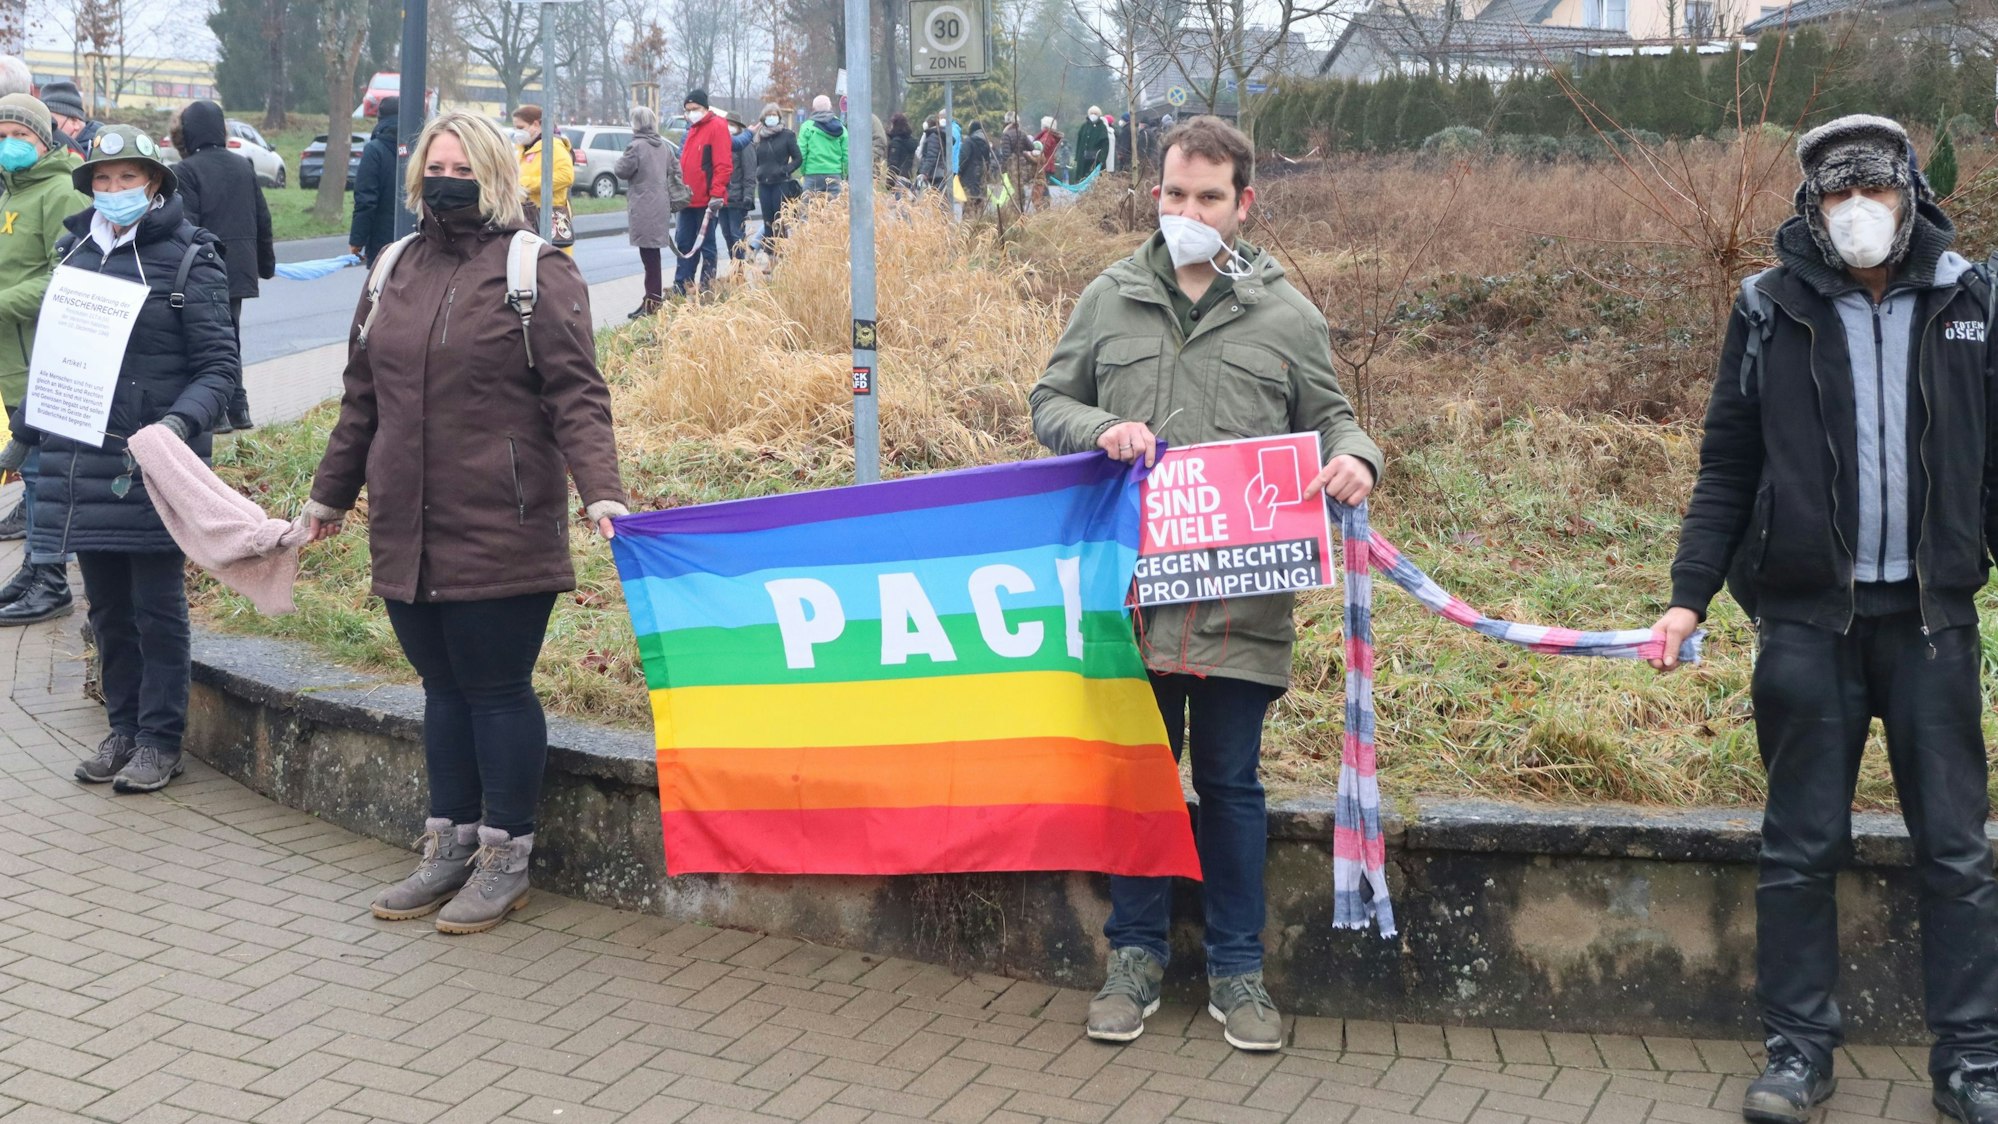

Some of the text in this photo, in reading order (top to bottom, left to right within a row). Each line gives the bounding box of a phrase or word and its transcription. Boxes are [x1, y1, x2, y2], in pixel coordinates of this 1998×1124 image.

[934, 19, 959, 39] 30
[929, 56, 967, 70] ZONE
[53, 294, 130, 319] MENSCHENRECHTE
[1952, 321, 1984, 330] TOTEN
[62, 357, 83, 368] Artikel
[853, 373, 867, 381] CK
[1147, 457, 1207, 490] WIR
[1145, 485, 1221, 520] SIND
[1147, 513, 1229, 548] VIELE
[1134, 540, 1313, 579] GEGEN RECHTS!
[1139, 566, 1317, 603] PRO IMPFUNG!
